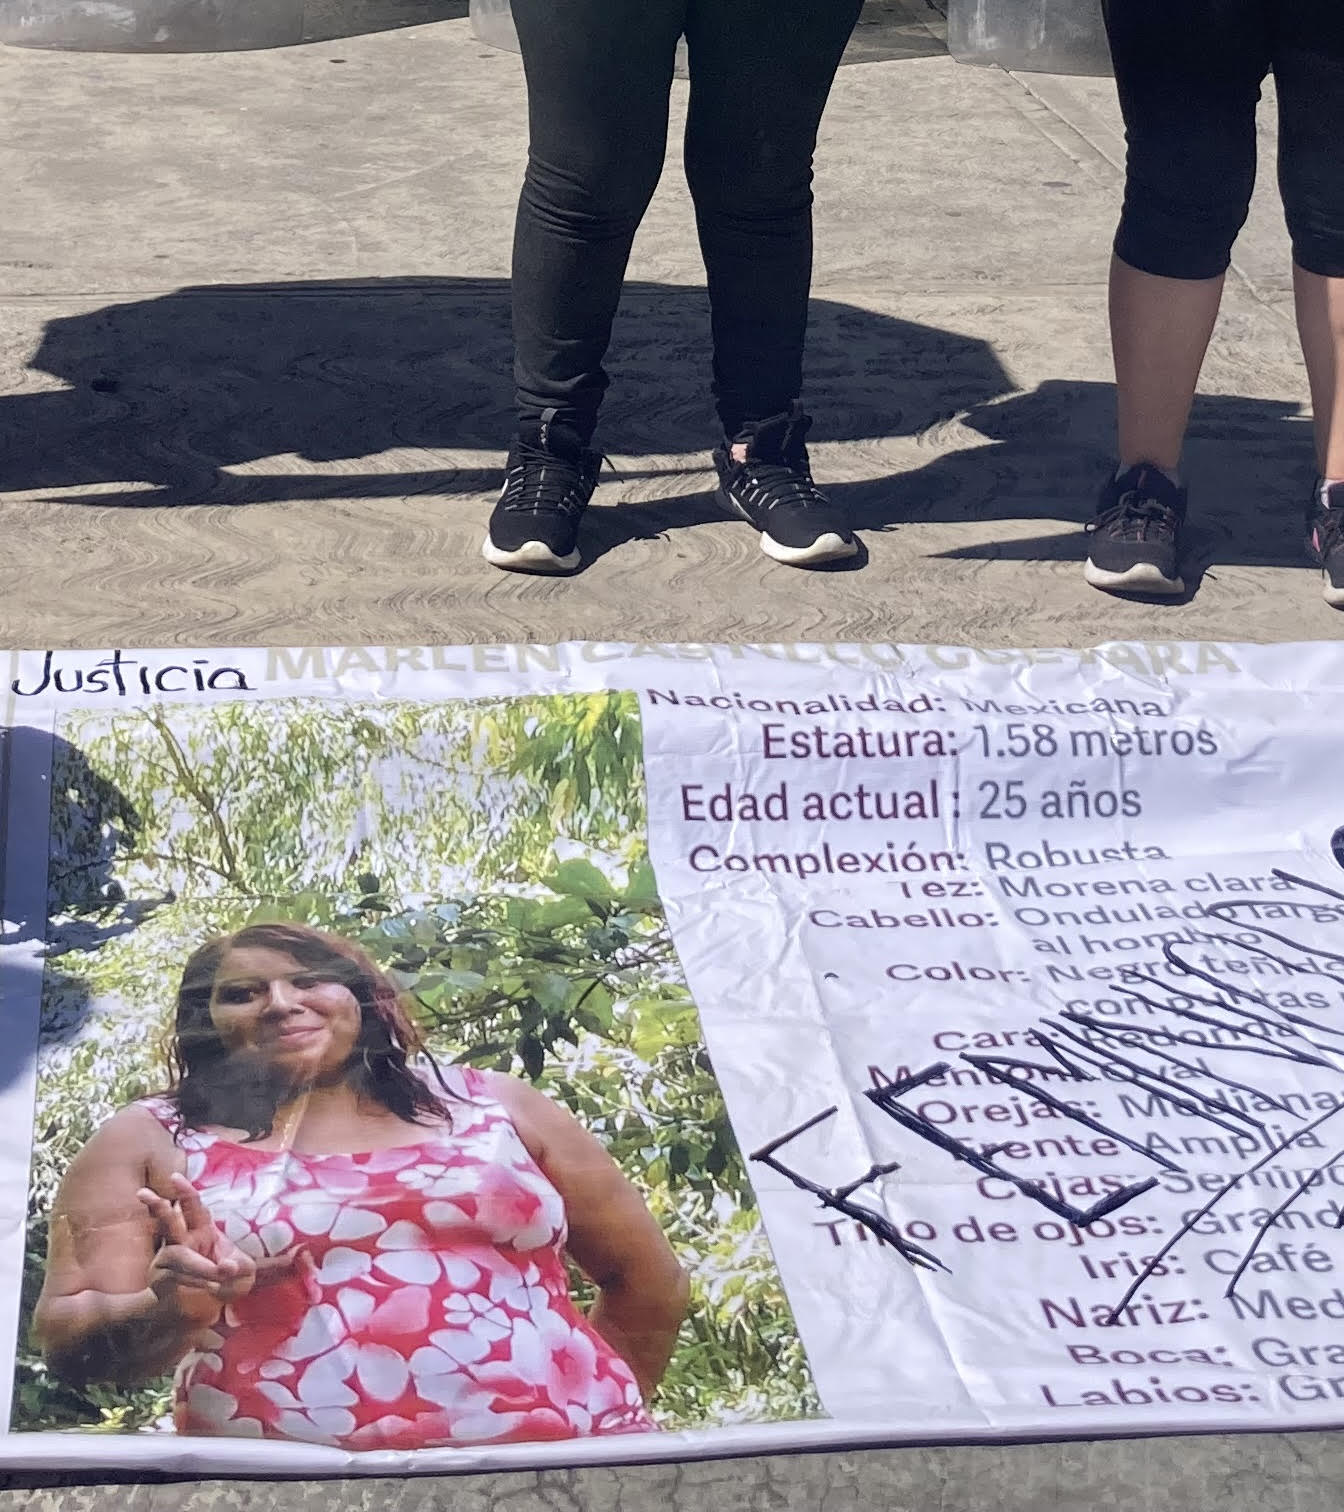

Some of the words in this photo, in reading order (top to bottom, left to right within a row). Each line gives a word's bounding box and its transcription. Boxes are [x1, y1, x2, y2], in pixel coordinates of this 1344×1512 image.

[12, 650, 257, 697] Justicia
[648, 689, 946, 715] Nacionalidad:
[963, 695, 1167, 718] Mexicana
[761, 725, 957, 760] Estatura:
[972, 724, 1057, 759] 1.58
[1071, 725, 1219, 758] metros
[682, 784, 788, 822] Edad
[978, 781, 1027, 819] 25
[1040, 781, 1142, 818] años
[689, 843, 966, 879] Complexión:
[986, 841, 1171, 869] Robusta
[1002, 876, 1176, 898] Morena
[811, 909, 999, 928] Cabello:
[1033, 933, 1064, 956] al
[886, 962, 1031, 983] Color:
[952, 1217, 1018, 1243] de
[1203, 1242, 1334, 1277] Café
[1067, 1345, 1233, 1366] Boca:
[1041, 1382, 1258, 1408] Labios:
